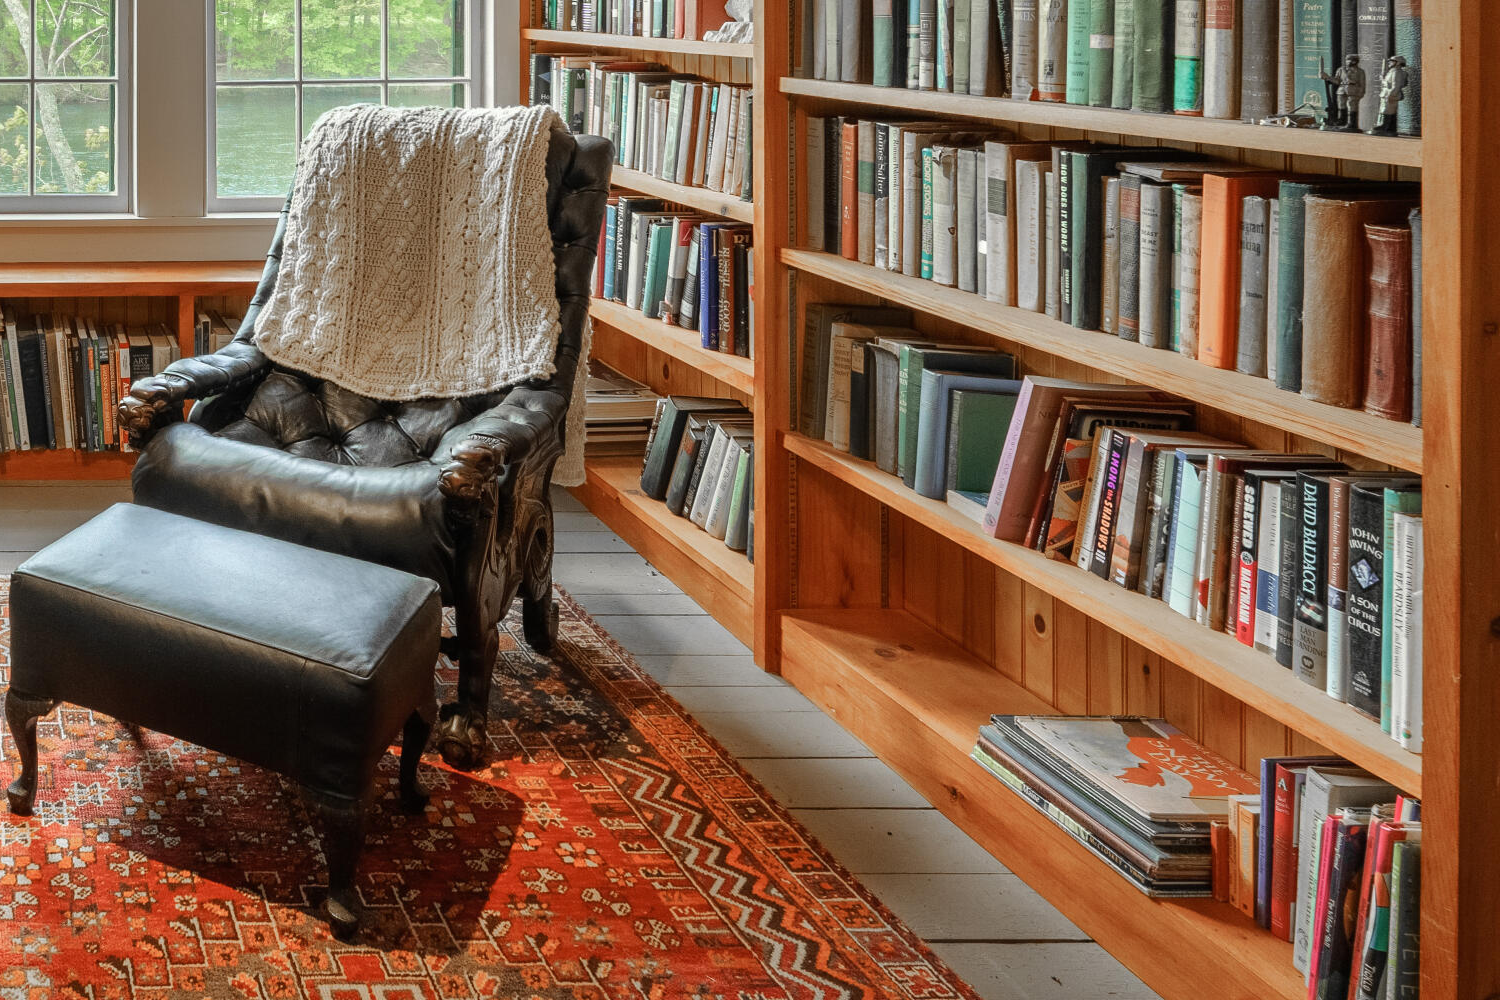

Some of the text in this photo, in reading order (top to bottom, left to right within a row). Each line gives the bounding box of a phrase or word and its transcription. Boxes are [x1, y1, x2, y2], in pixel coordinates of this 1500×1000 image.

[1302, 2, 1324, 12] Poetry
[876, 130, 886, 194] James Salter
[923, 154, 932, 216] SHORT STORIES
[1060, 163, 1068, 252] HOW DOES IT WORK?
[722, 246, 731, 333] RUSSELL GOOD
[133, 357, 149, 366] ART
[1097, 450, 1121, 551] AMONG the SHADOWS
[1240, 485, 1255, 549] SCREWED
[1231, 534, 1240, 558] Morrie
[1302, 482, 1317, 596] DAVID BALDACCI
[1330, 486, 1341, 586] When Madeline Was Young
[1351, 526, 1380, 545] JOHN
[1349, 538, 1384, 560] IRVING
[1280, 539, 1295, 599] Black Spring
[1238, 566, 1252, 624] HARTMANN
[1266, 575, 1277, 611] Lincoln
[1349, 593, 1379, 613] A SON
[1394, 571, 1404, 632] BEARDSLEY
[1348, 615, 1381, 638] CIRCUS
[1350, 605, 1376, 623] OF THE
[1299, 625, 1317, 638] LAST
[1300, 634, 1316, 647] MAN
[1294, 639, 1327, 659] TANDING
[1393, 655, 1402, 677] world
[1147, 752, 1201, 779] DAY
[1147, 740, 1244, 794] SNOWY
[1191, 754, 1229, 776] THE
[1022, 783, 1040, 803] Maine
